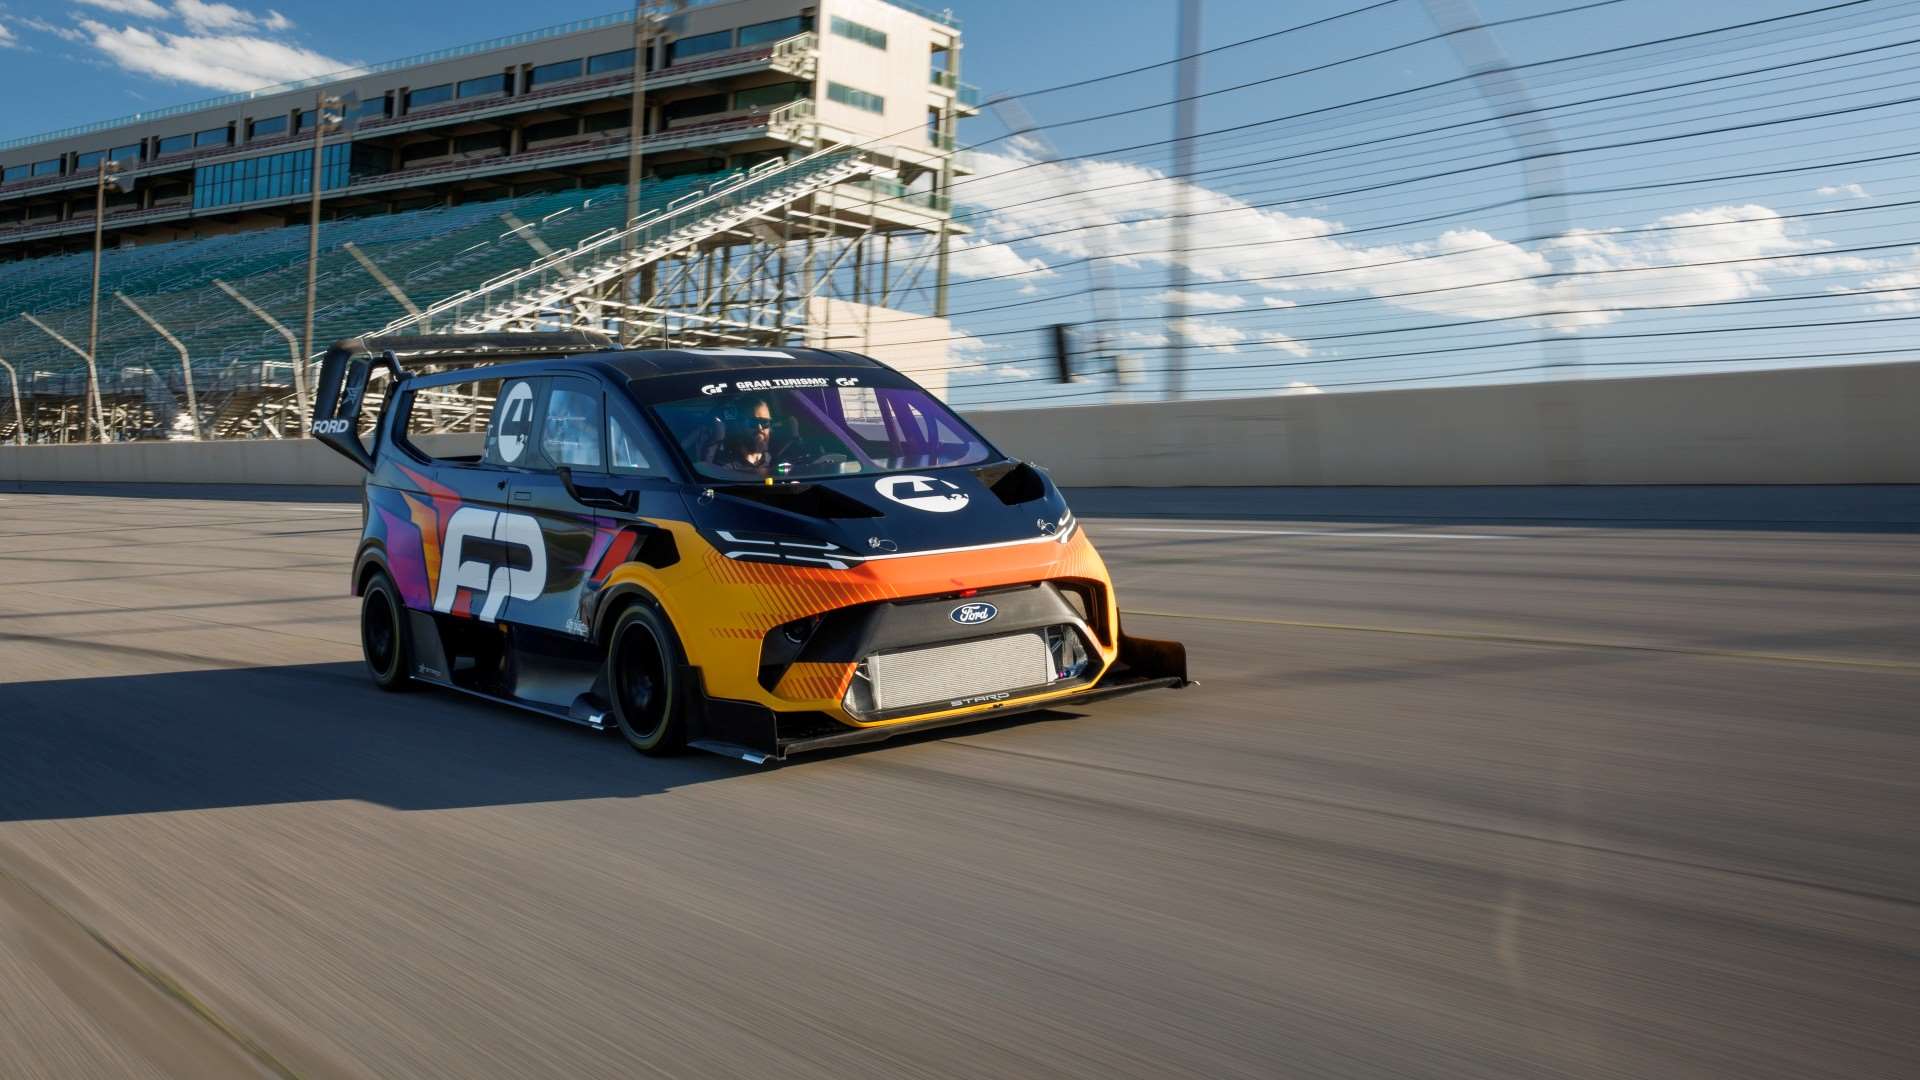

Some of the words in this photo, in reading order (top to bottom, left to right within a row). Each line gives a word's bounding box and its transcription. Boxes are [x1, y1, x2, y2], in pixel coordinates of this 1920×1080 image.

[736, 379, 771, 389] GRAN
[773, 377, 827, 386] TURISMO
[312, 420, 349, 434] FORD
[433, 507, 547, 623] FP
[960, 605, 988, 621] Ford
